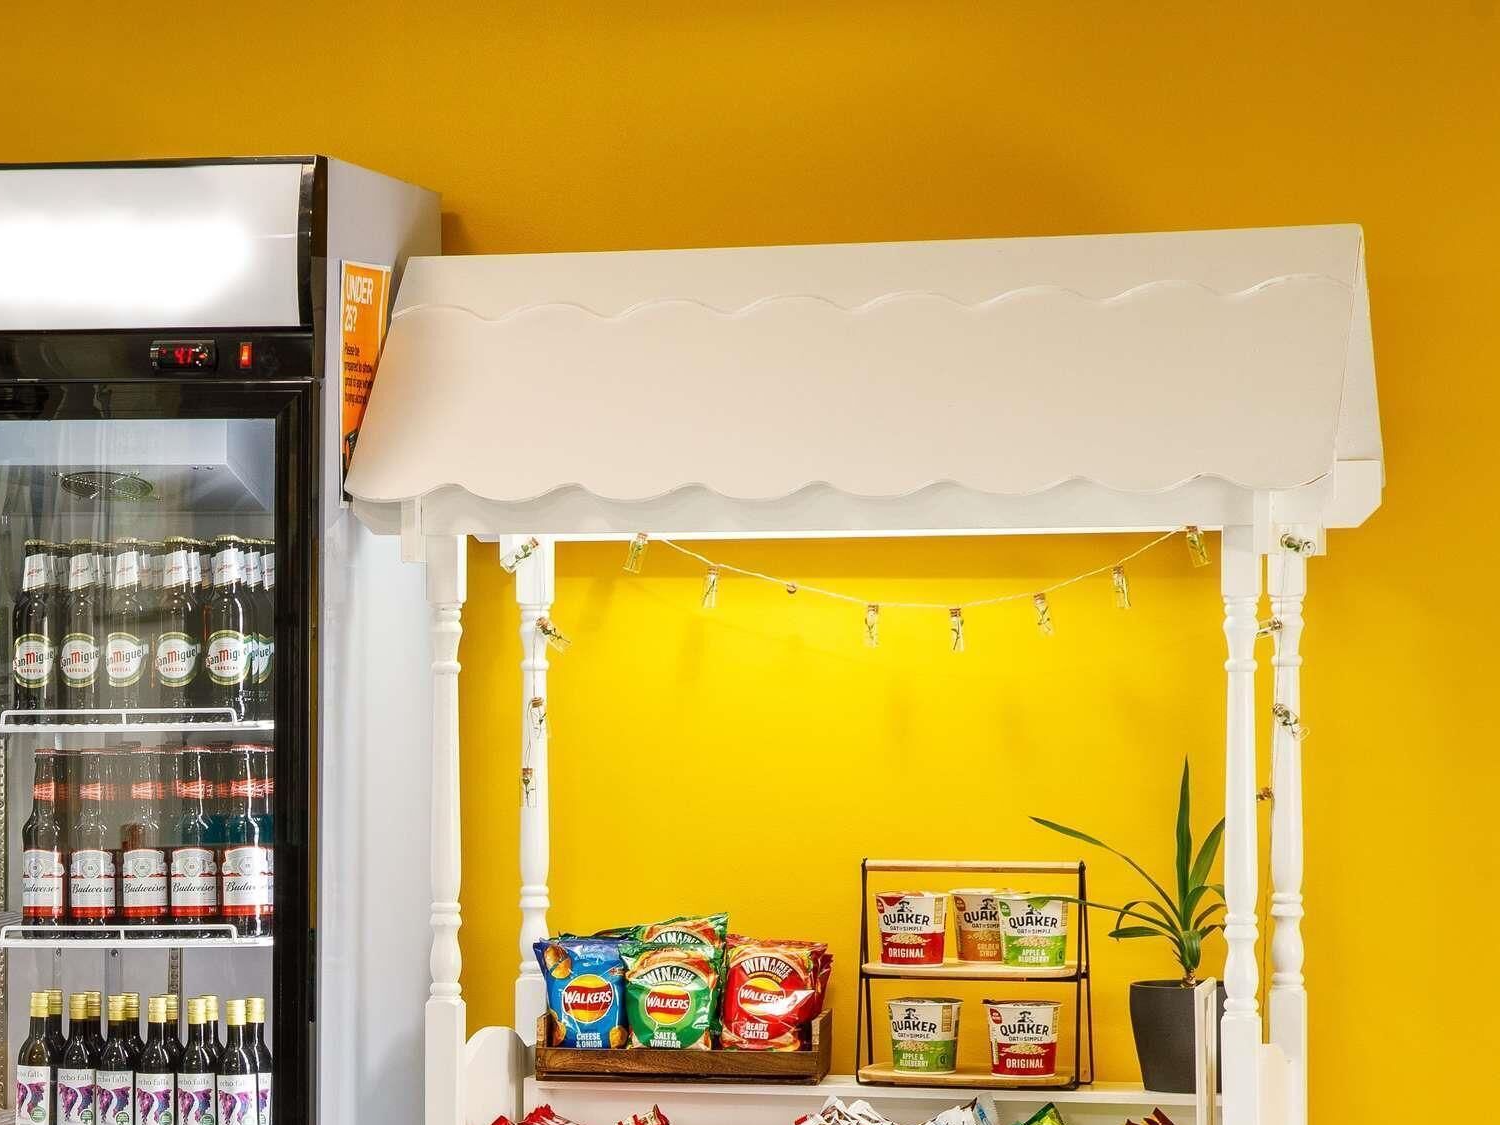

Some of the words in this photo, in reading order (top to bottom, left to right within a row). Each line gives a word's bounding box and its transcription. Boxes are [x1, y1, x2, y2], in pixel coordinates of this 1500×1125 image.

[345, 273, 373, 305] UNDER
[71, 882, 113, 894] Budweiser
[124, 881, 166, 893] Budweiser
[172, 882, 215, 892] Budweiser
[883, 913, 930, 926] QUAKER
[963, 910, 998, 924] QUAK
[1009, 916, 1058, 928] QUAKER
[888, 947, 924, 958] ORIGINAL
[741, 956, 771, 975] WIN
[564, 990, 612, 1004] WALKERS
[647, 996, 689, 1010] WALKERS
[745, 1021, 769, 1032] READY
[892, 1020, 937, 1033] QUAKER
[1000, 1023, 1049, 1036] QUAKER
[576, 1032, 600, 1041] CHEESE
[654, 1031, 670, 1040] SALT
[743, 1031, 769, 1040] SALTED
[582, 1040, 603, 1048] ONION
[650, 1040, 681, 1049] VINEGAR
[1006, 1058, 1044, 1069] ORIGINAL
